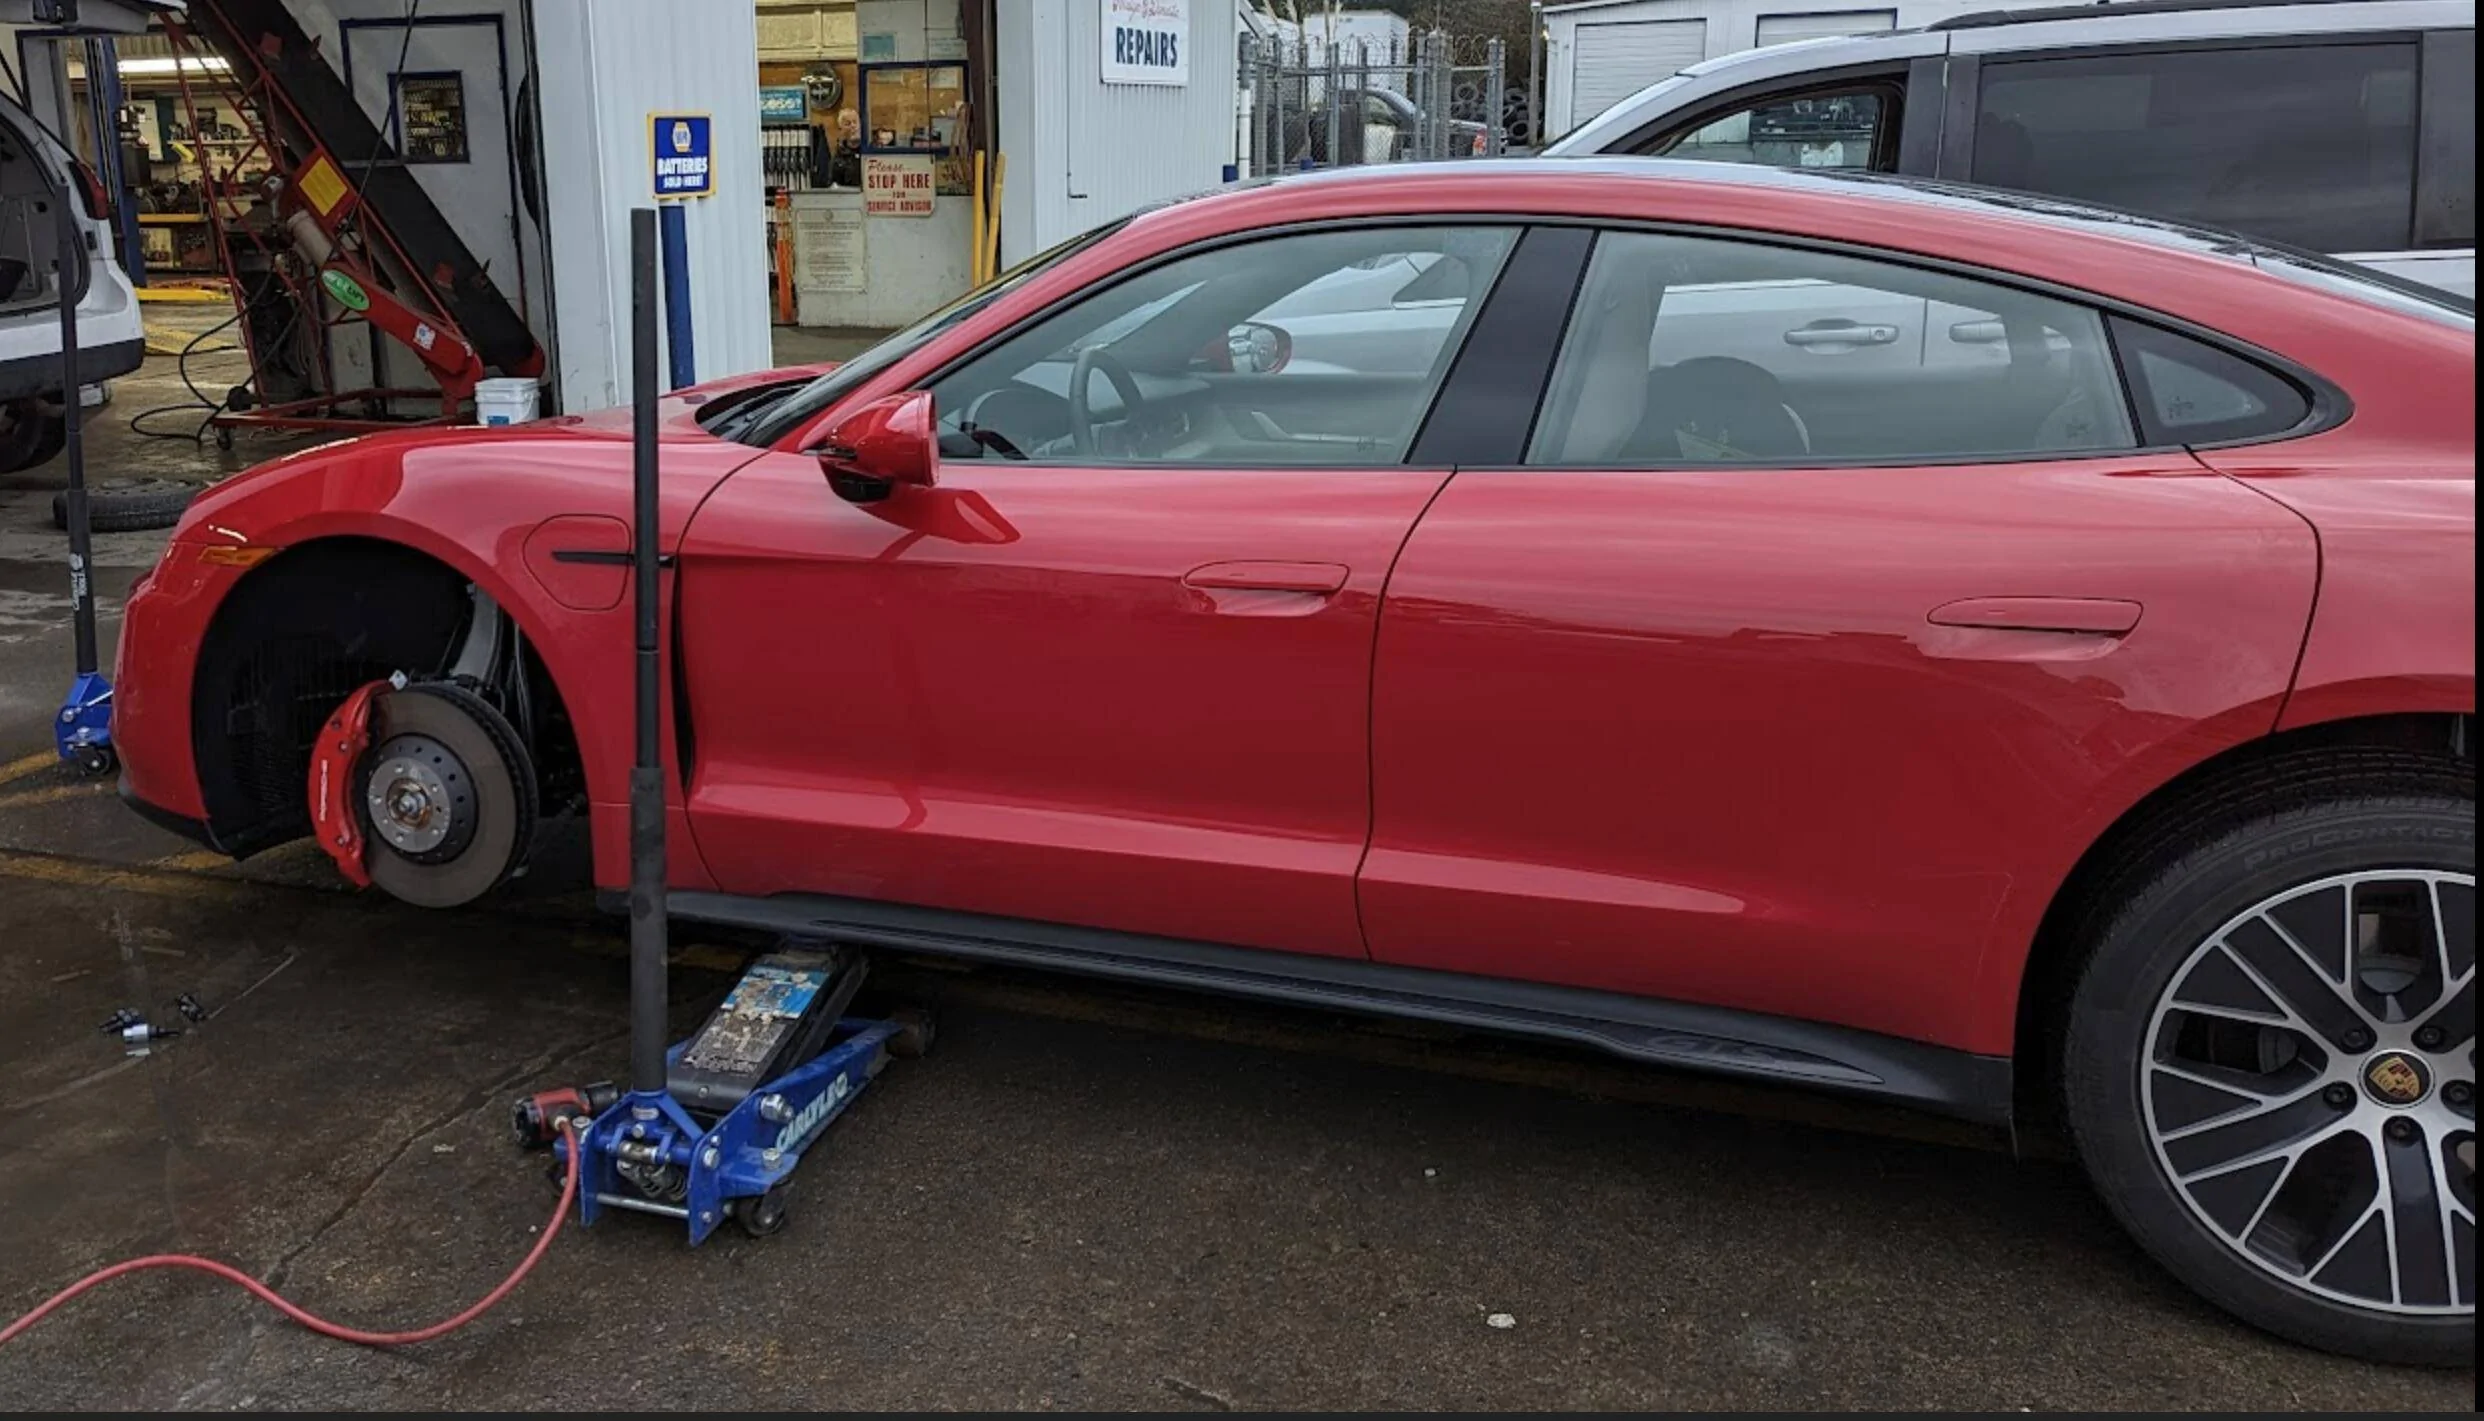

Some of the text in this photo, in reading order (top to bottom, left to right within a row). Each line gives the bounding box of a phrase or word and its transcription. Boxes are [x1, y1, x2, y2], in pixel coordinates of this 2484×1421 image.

[1116, 26, 1177, 68] REPAIRS
[657, 156, 708, 175] BATTERIES
[663, 176, 682, 188] SOLD
[868, 173, 930, 189] STOP HERE
